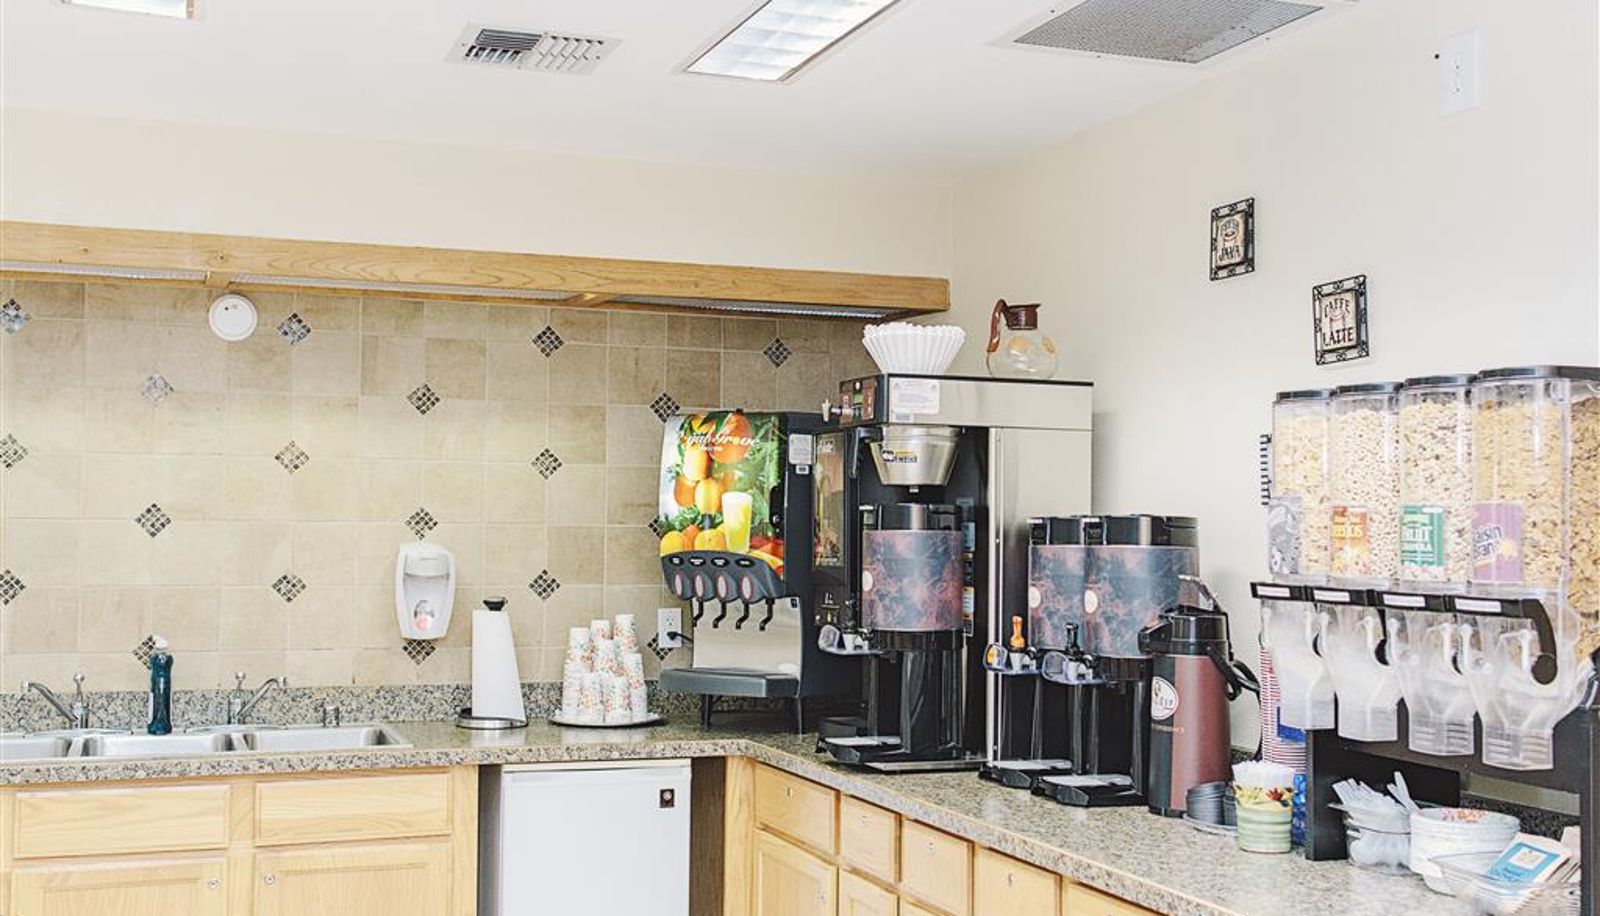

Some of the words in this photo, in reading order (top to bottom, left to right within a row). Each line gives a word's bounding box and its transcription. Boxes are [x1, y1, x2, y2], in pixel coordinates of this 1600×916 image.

[1219, 245, 1241, 261] JAVA
[1324, 298, 1351, 318] CAFFE
[1323, 326, 1354, 346] LATTE
